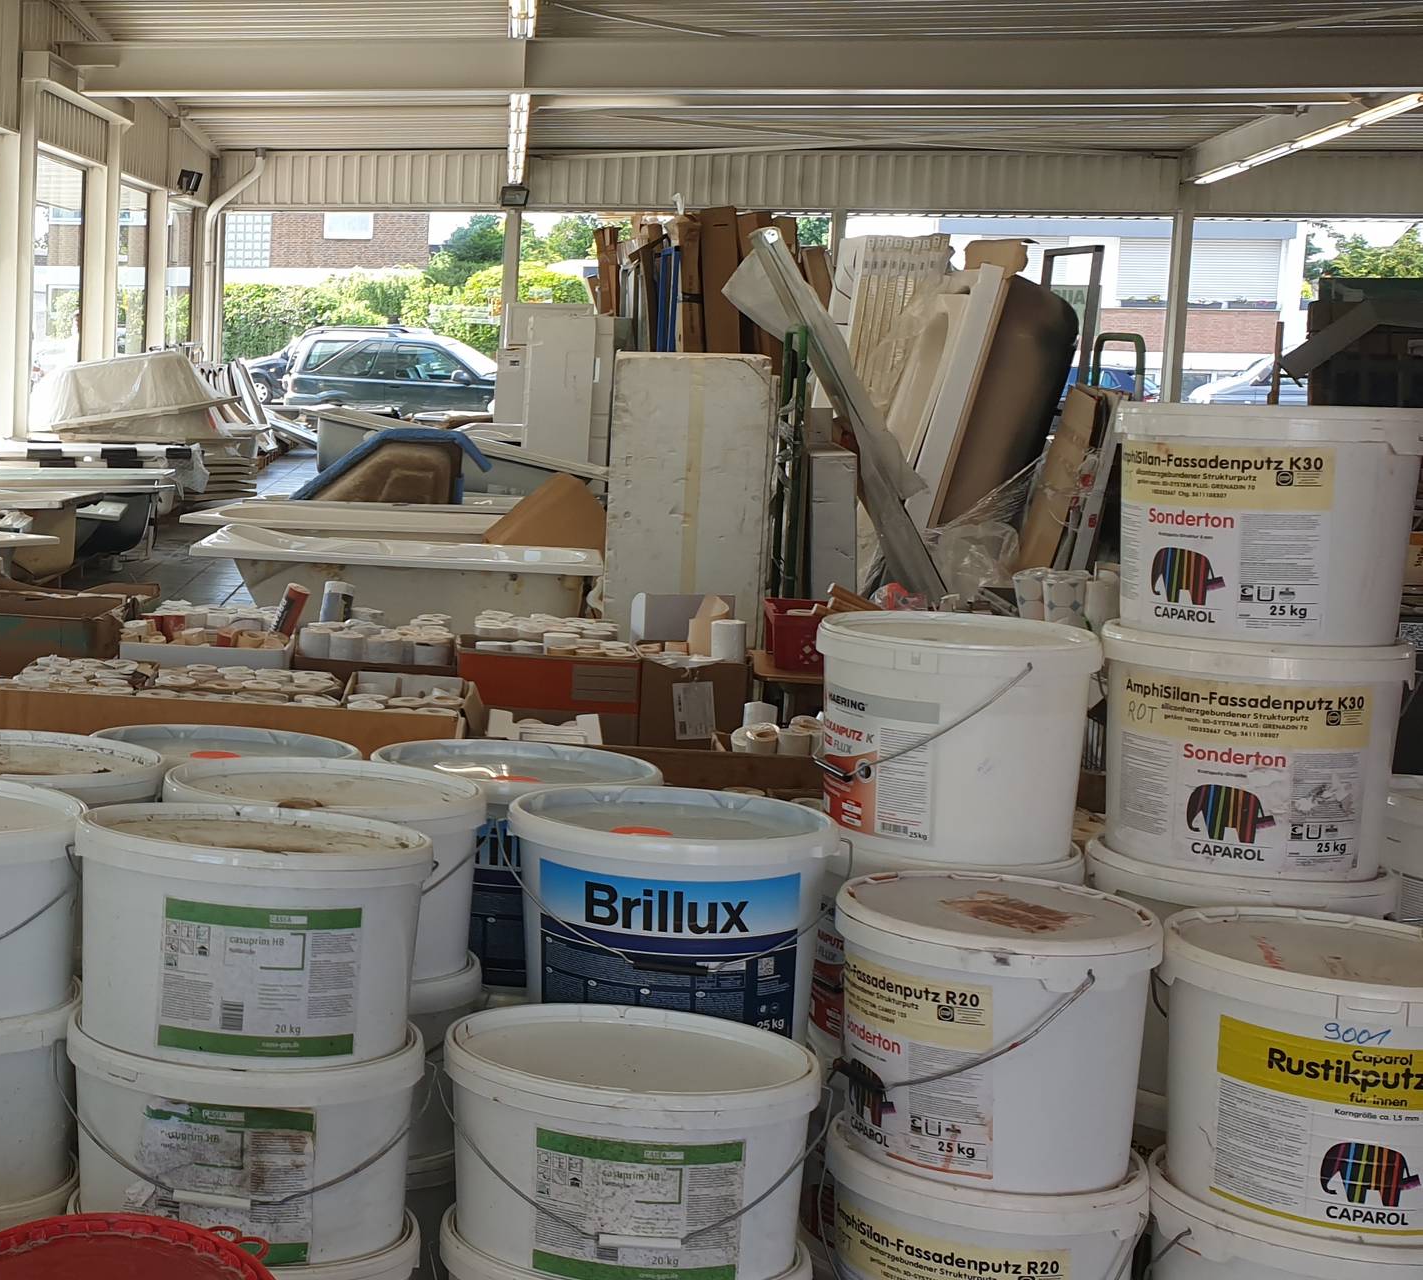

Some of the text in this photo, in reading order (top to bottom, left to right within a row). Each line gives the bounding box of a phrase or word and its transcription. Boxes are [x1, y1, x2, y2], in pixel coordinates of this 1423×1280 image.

[1123, 451, 1323, 473] mphiSilan-Fassadenputz K30
[1148, 508, 1235, 529] Sonderton
[1154, 605, 1307, 624] CAPAROL 25 kg
[1126, 678, 1365, 717] AmphiSilan-Fassadenputz K30
[1128, 700, 1157, 724] ROT
[1253, 712, 1309, 722] Strukturputz
[1183, 743, 1287, 768] Sonderton
[1191, 842, 1346, 862] CAPAROL 25 kg
[584, 880, 750, 935] Brillux
[945, 990, 980, 1007] R20
[275, 1024, 301, 1036] 20 kg
[1324, 1022, 1392, 1045] 9001
[1352, 1050, 1413, 1067] Caparol
[1268, 1047, 1423, 1092] Rustikputz
[938, 1141, 954, 1153] 25
[957, 1143, 975, 1159] kg
[1326, 1206, 1409, 1226] CAPAROL
[652, 1256, 679, 1268] 20 kg
[1027, 1261, 1059, 1275] R20
